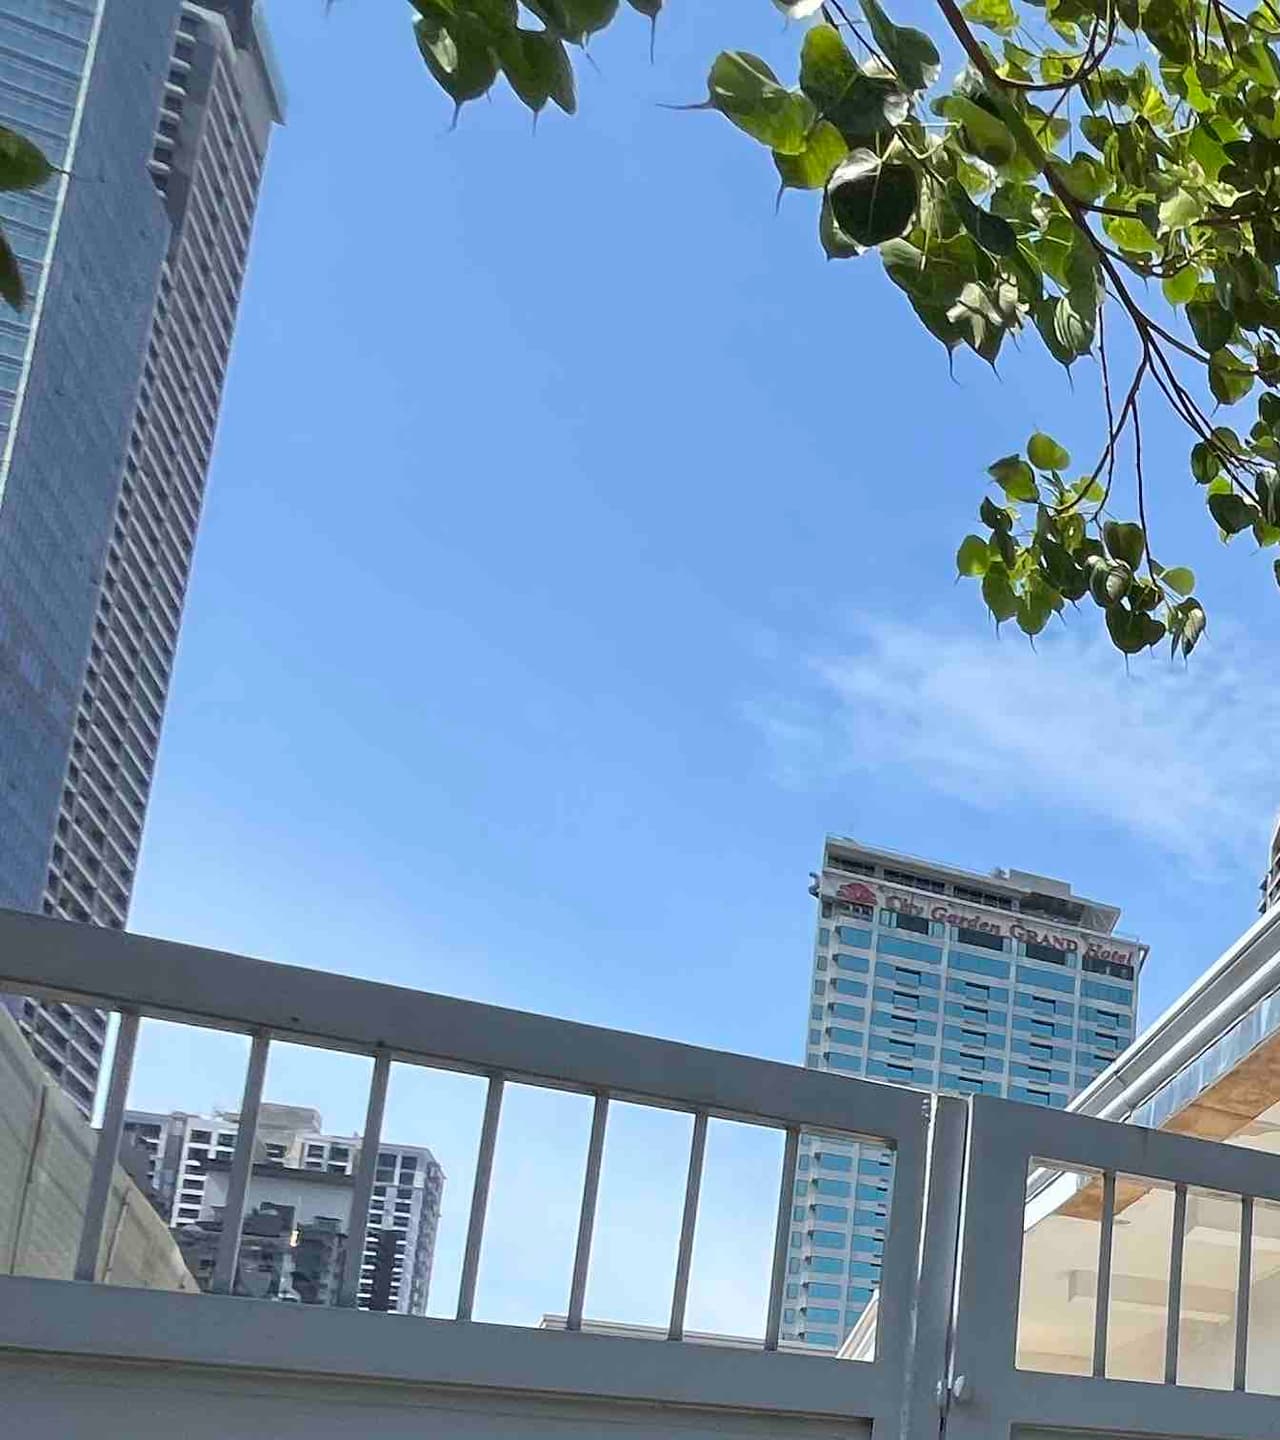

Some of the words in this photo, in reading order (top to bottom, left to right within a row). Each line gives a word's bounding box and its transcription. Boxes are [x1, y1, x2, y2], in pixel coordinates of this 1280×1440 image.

[930, 906, 1002, 936] Garden
[1009, 923, 1079, 952] GRAND
[1084, 942, 1134, 964] Hotel
